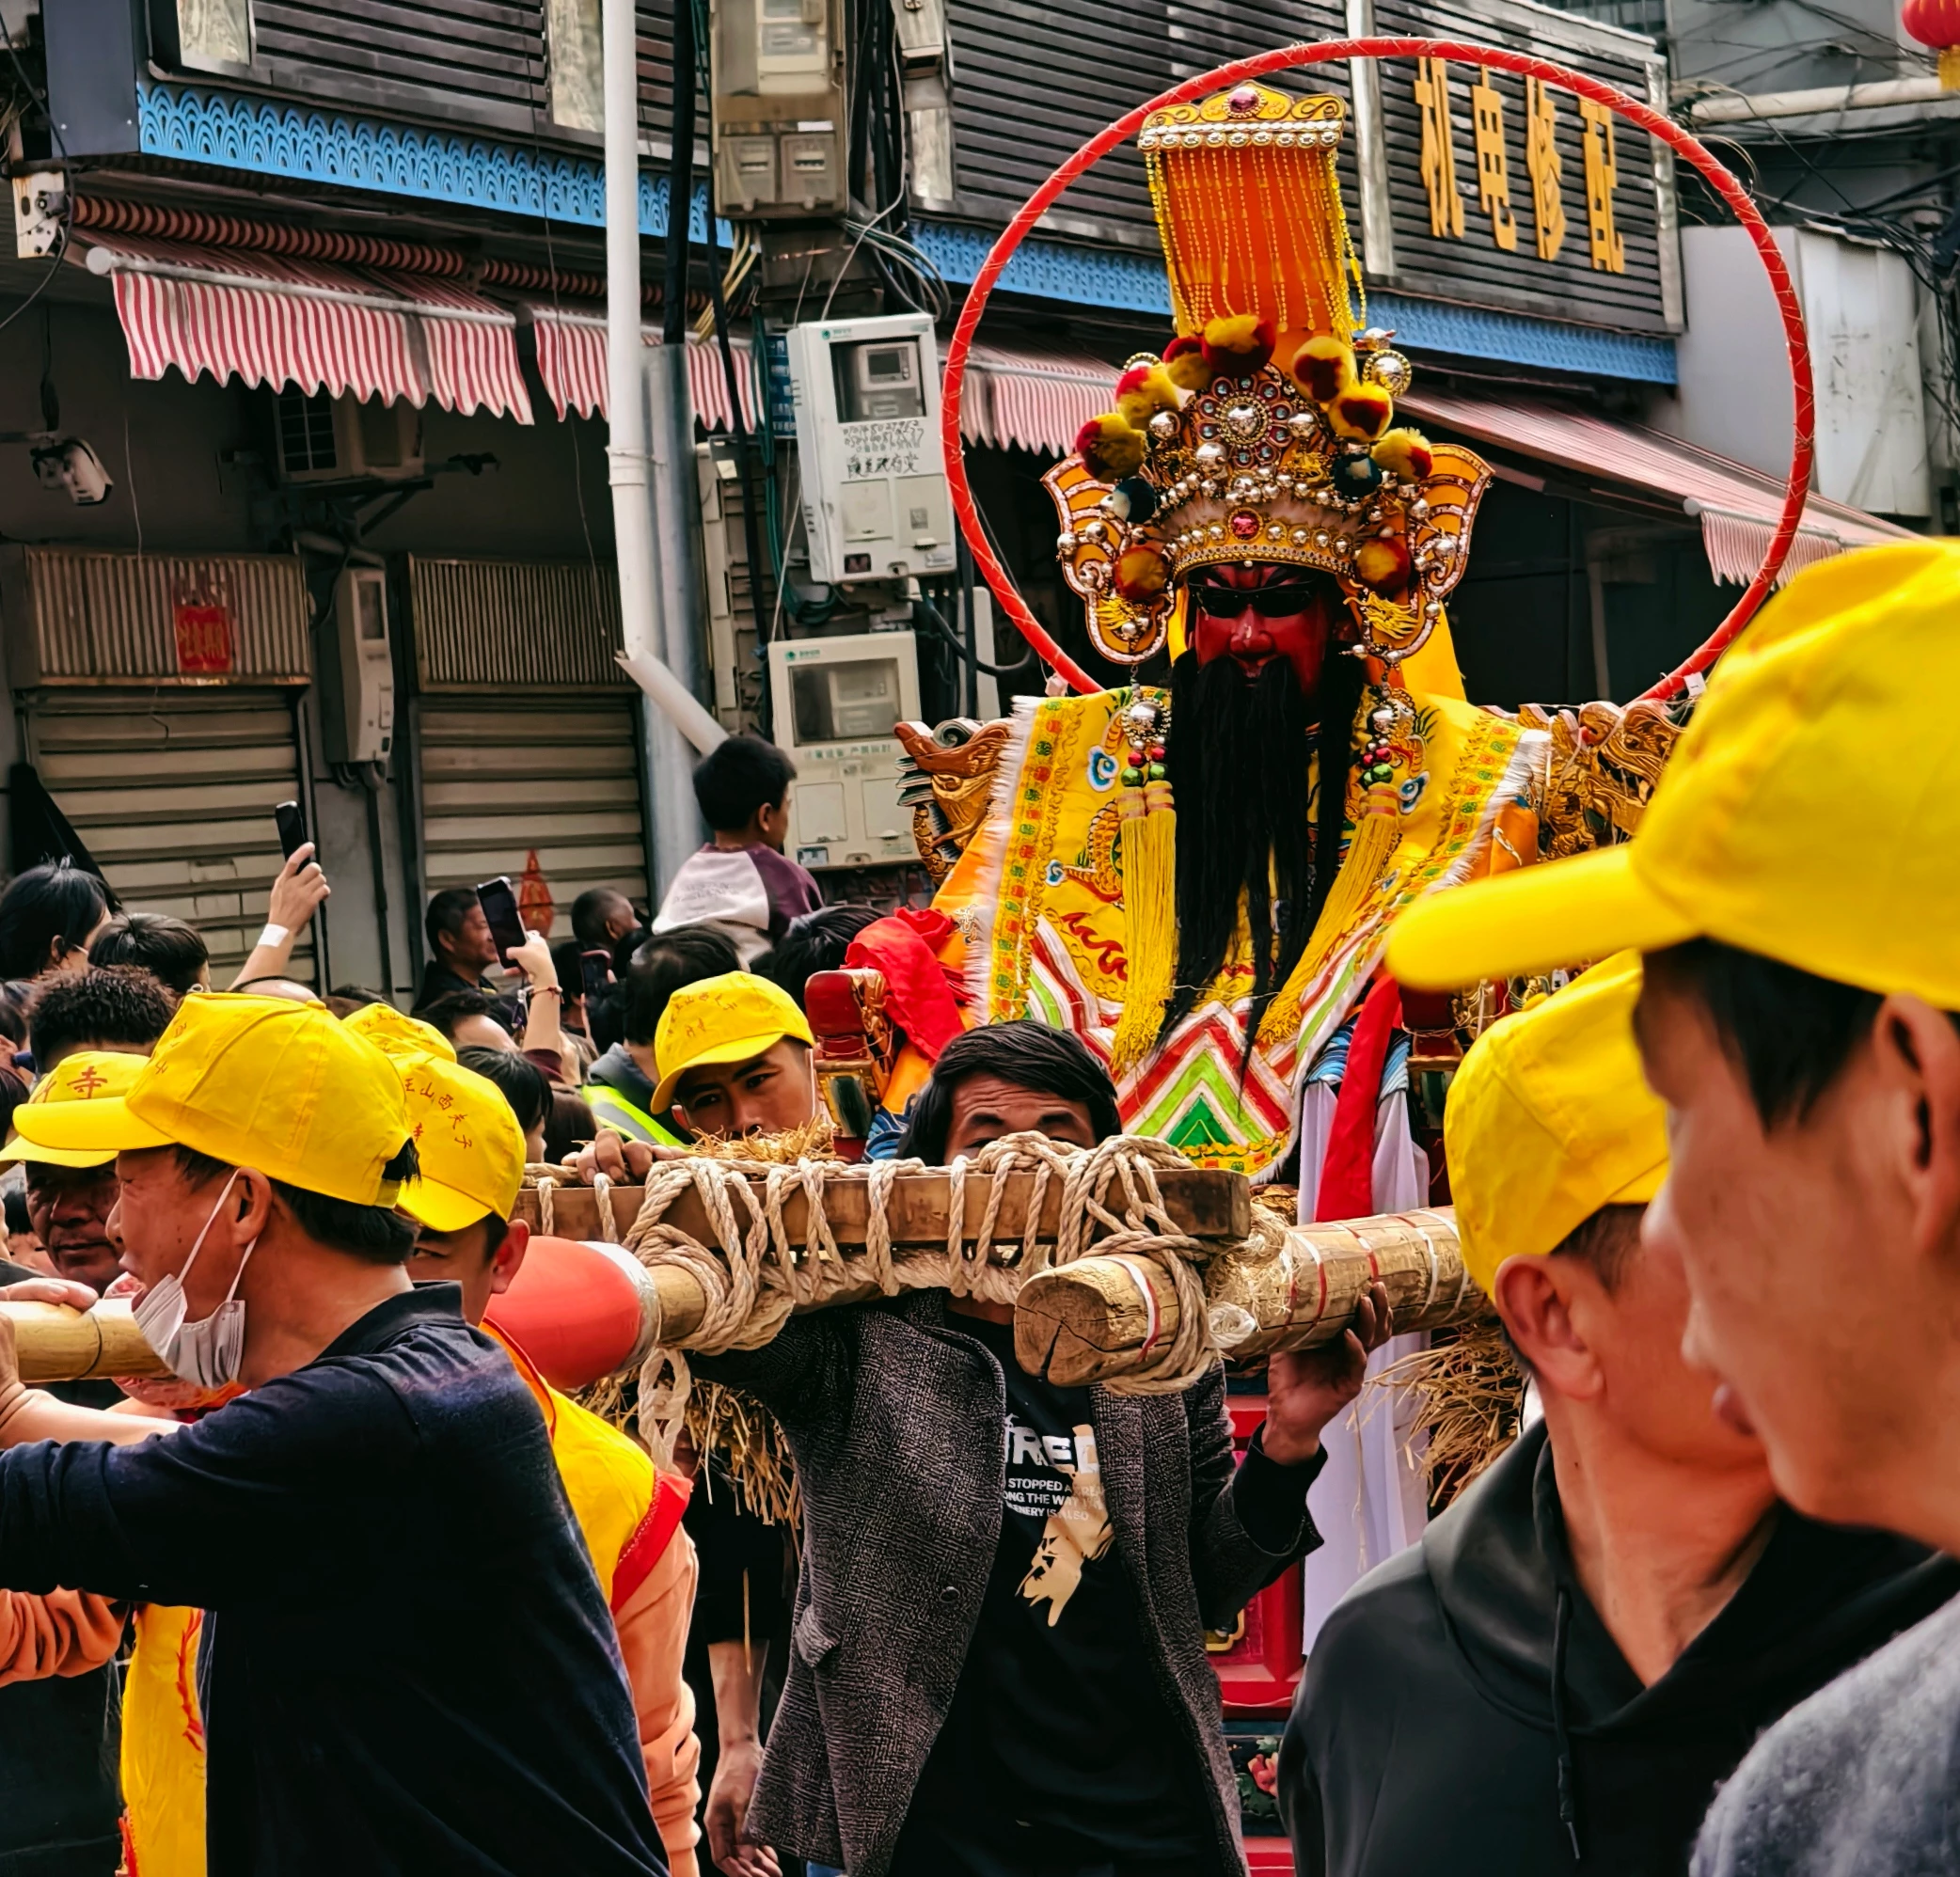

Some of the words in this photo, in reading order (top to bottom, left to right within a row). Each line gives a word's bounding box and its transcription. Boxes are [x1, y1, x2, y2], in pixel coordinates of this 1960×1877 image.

[1414, 55, 1625, 274] 机电修配
[1007, 1477, 1063, 1492] STOPPED
[1002, 1490, 1025, 1503] ONG
[1025, 1491, 1051, 1505] THE
